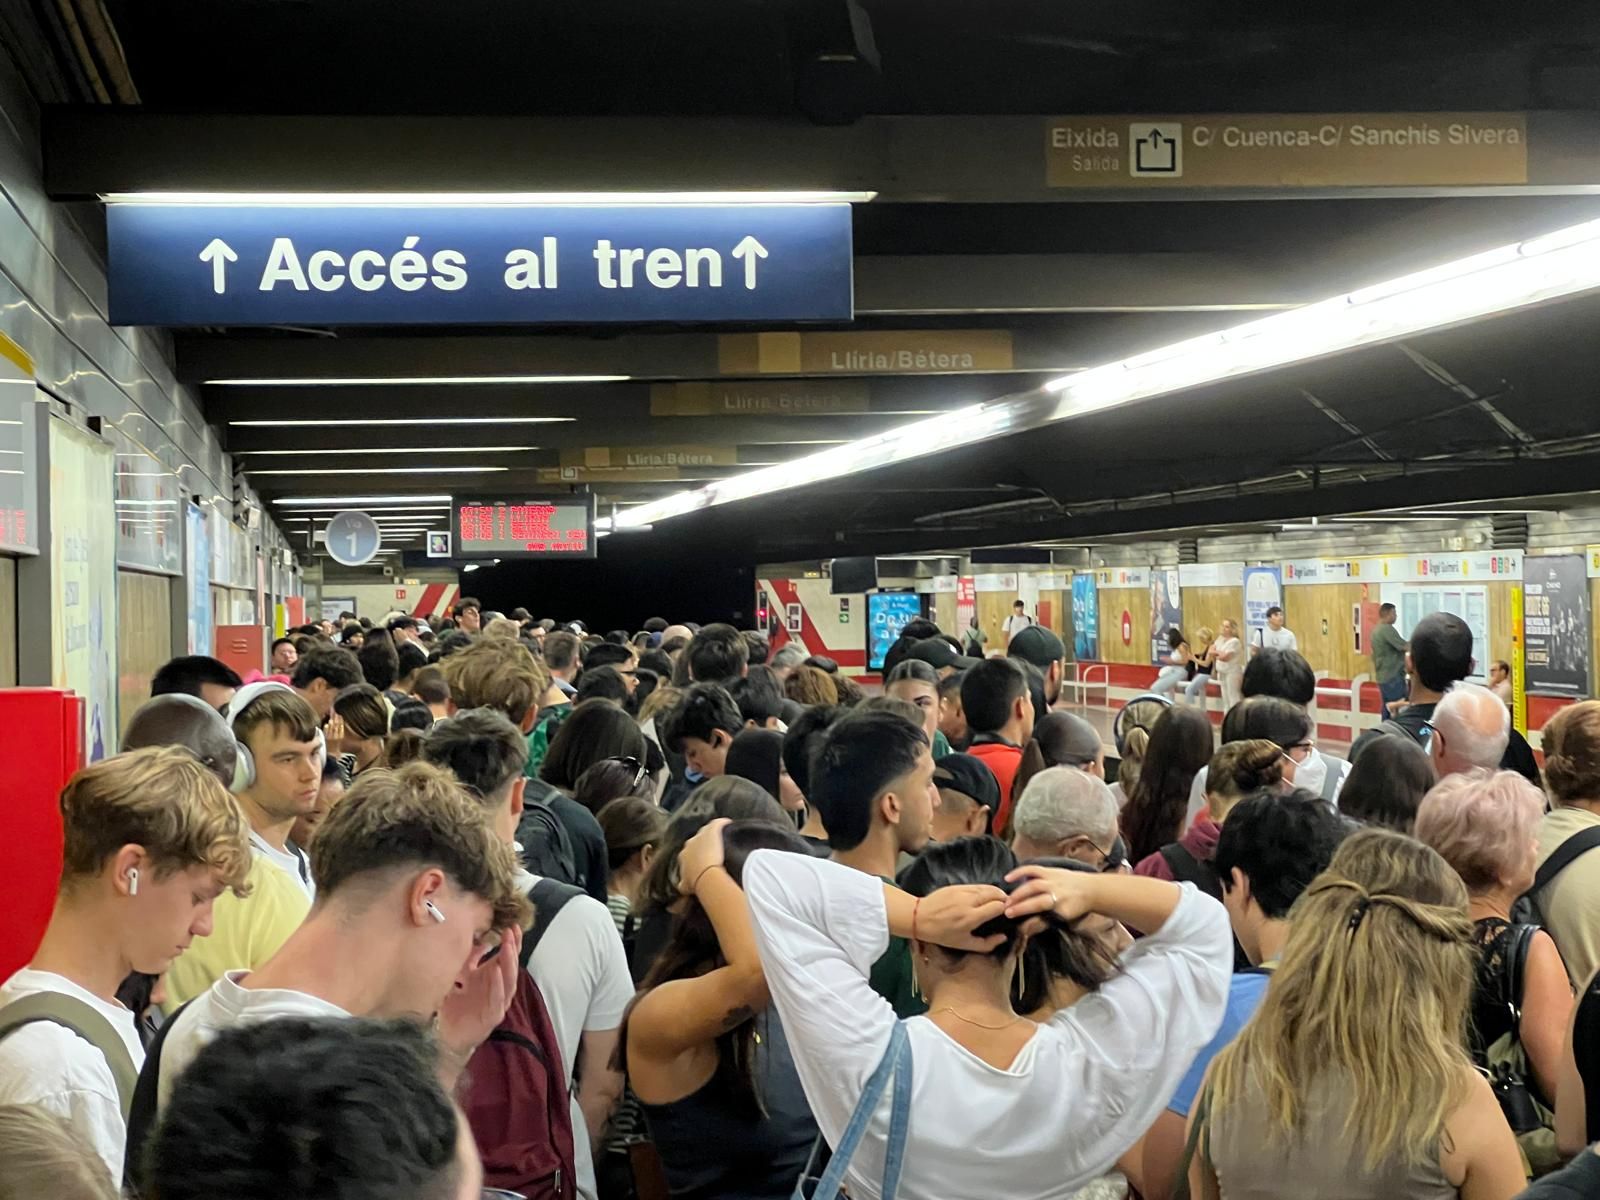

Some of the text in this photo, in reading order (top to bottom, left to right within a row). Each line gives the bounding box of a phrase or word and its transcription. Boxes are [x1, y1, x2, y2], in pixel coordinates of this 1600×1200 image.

[1051, 127, 1119, 148] Eixida
[1192, 123, 1520, 148] C/ Cuenca-C/ Sanchis Sivera
[1072, 154, 1120, 172] Salida
[259, 236, 722, 291] Accés al tren
[345, 531, 357, 558] 1
